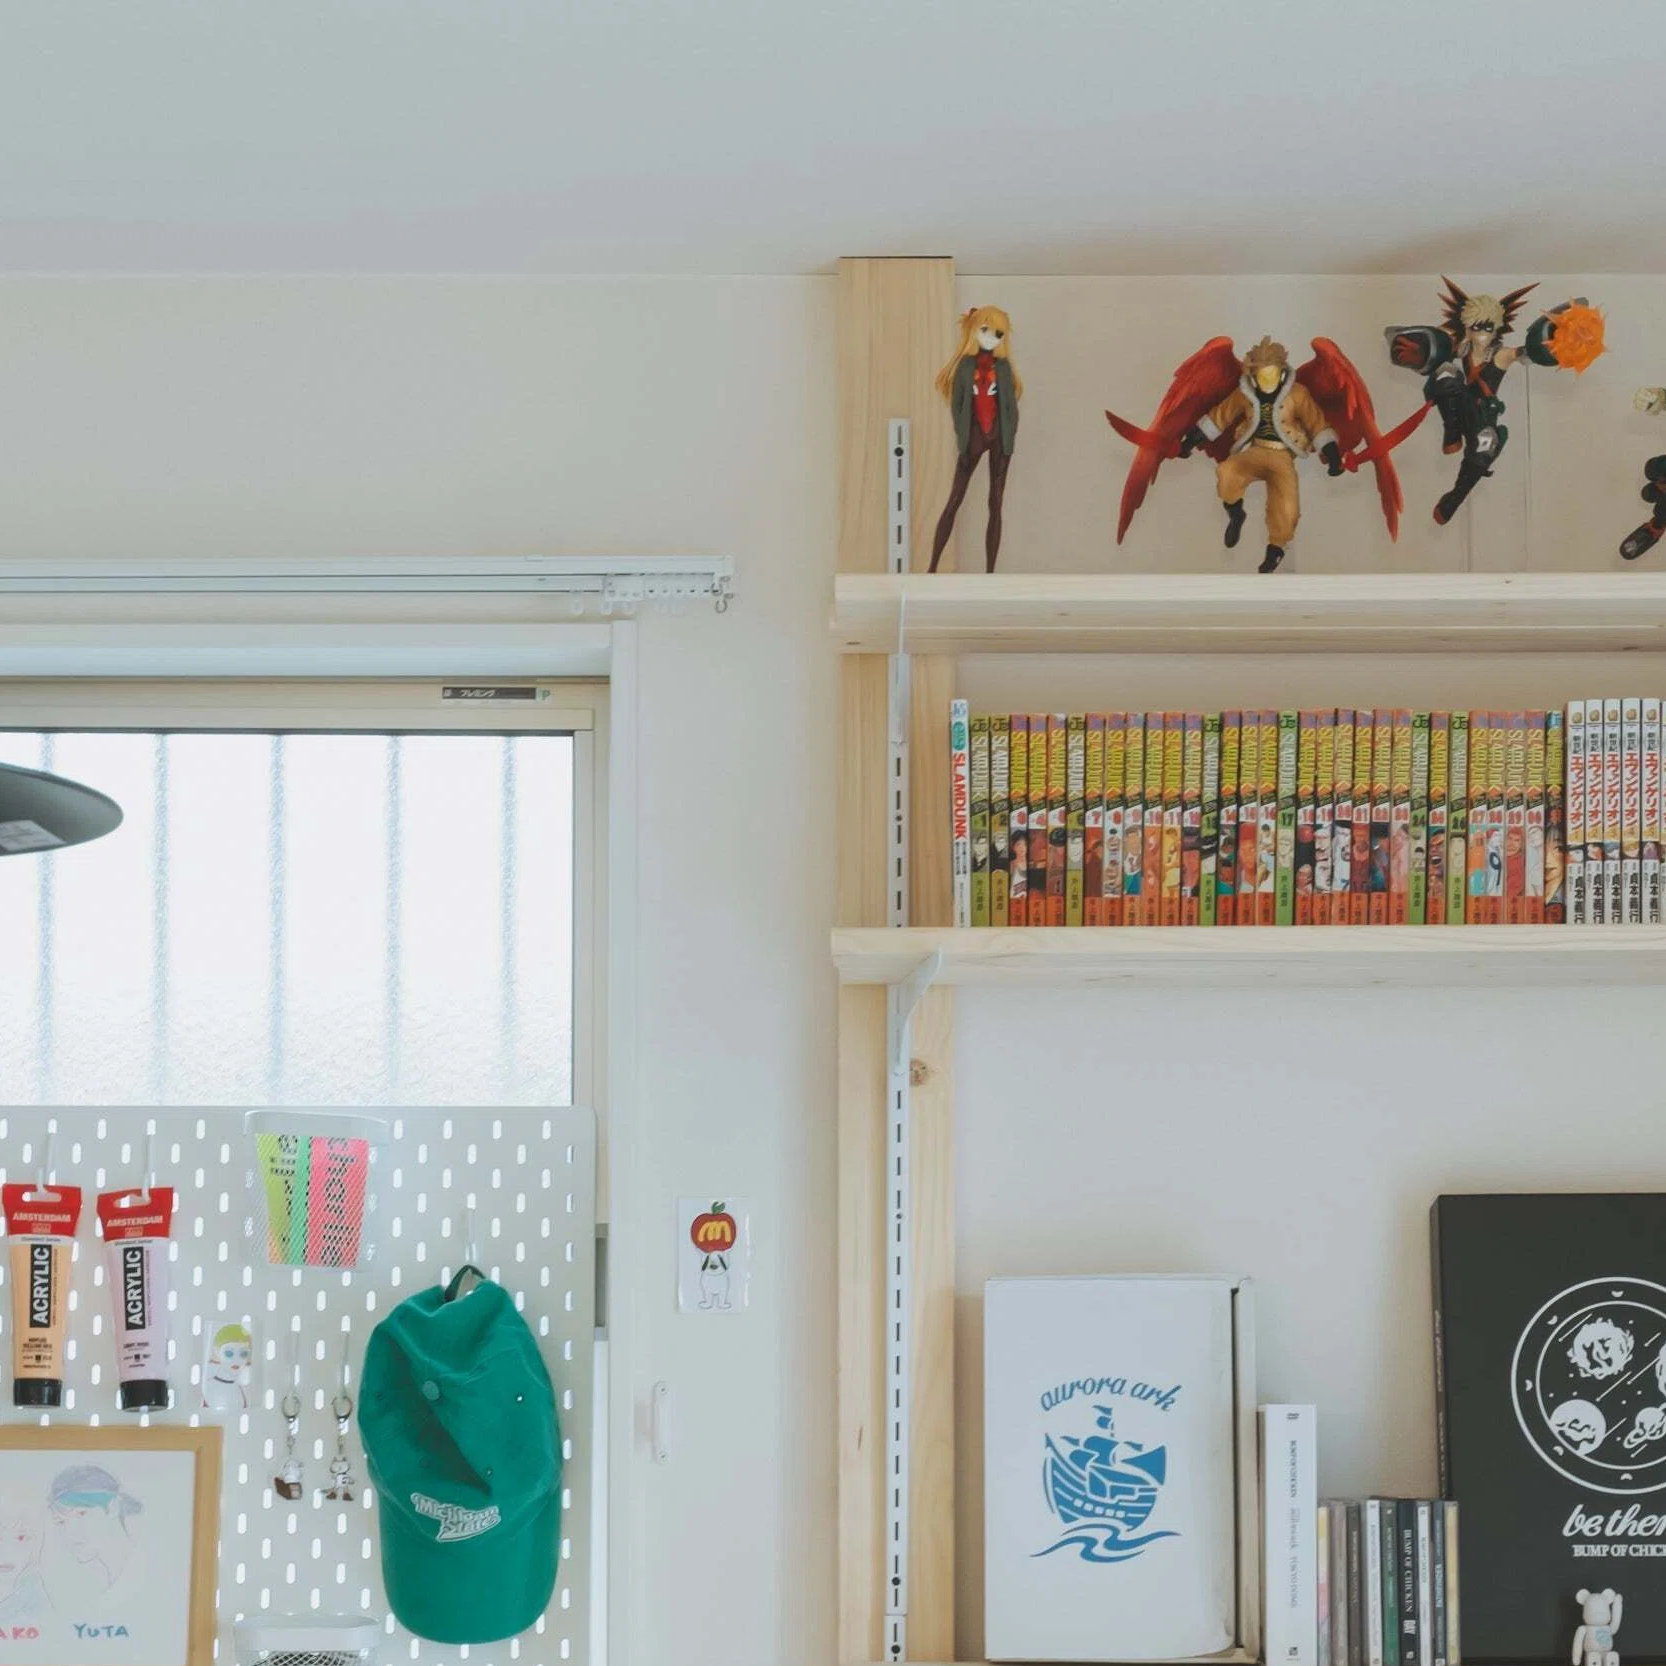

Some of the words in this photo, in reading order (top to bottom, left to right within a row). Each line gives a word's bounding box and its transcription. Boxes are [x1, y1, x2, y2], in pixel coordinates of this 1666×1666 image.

[953, 753, 966, 839] SLAMDUNK
[12, 1212, 71, 1222] AMSTERDAM
[106, 1215, 164, 1228] AMSTERDAM
[32, 1247, 49, 1325] ACRYLIC
[126, 1250, 143, 1326] ACRYLIC
[1040, 1377, 1127, 1411] aurora
[1130, 1382, 1182, 1412] ark
[1562, 1503, 1604, 1537] be
[1572, 1544, 1610, 1557] BUMP
[1610, 1544, 1629, 1557] OF
[74, 1624, 130, 1638] YUTA
